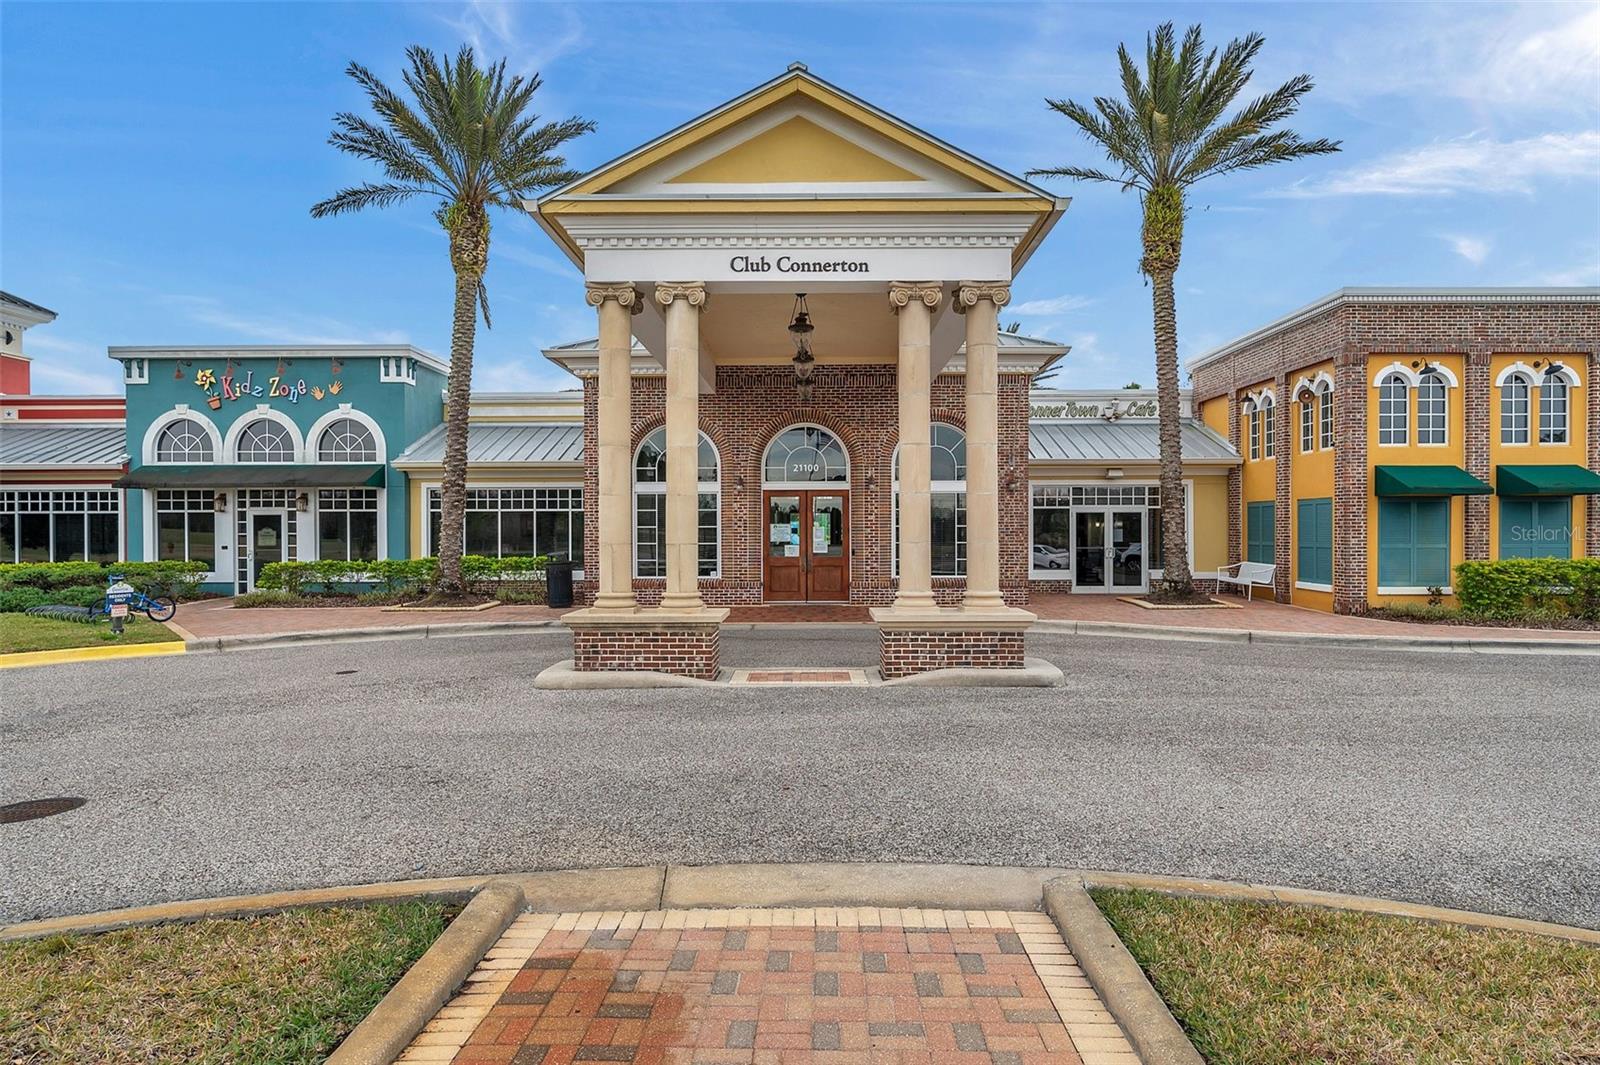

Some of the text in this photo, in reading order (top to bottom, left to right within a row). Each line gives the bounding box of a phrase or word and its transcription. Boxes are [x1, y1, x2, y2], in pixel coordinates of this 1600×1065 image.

[730, 256, 870, 273] Club Connerton
[220, 371, 307, 403] Kidz Zone
[1028, 400, 1157, 418] onnerTown Cafe
[793, 464, 820, 473] 21100
